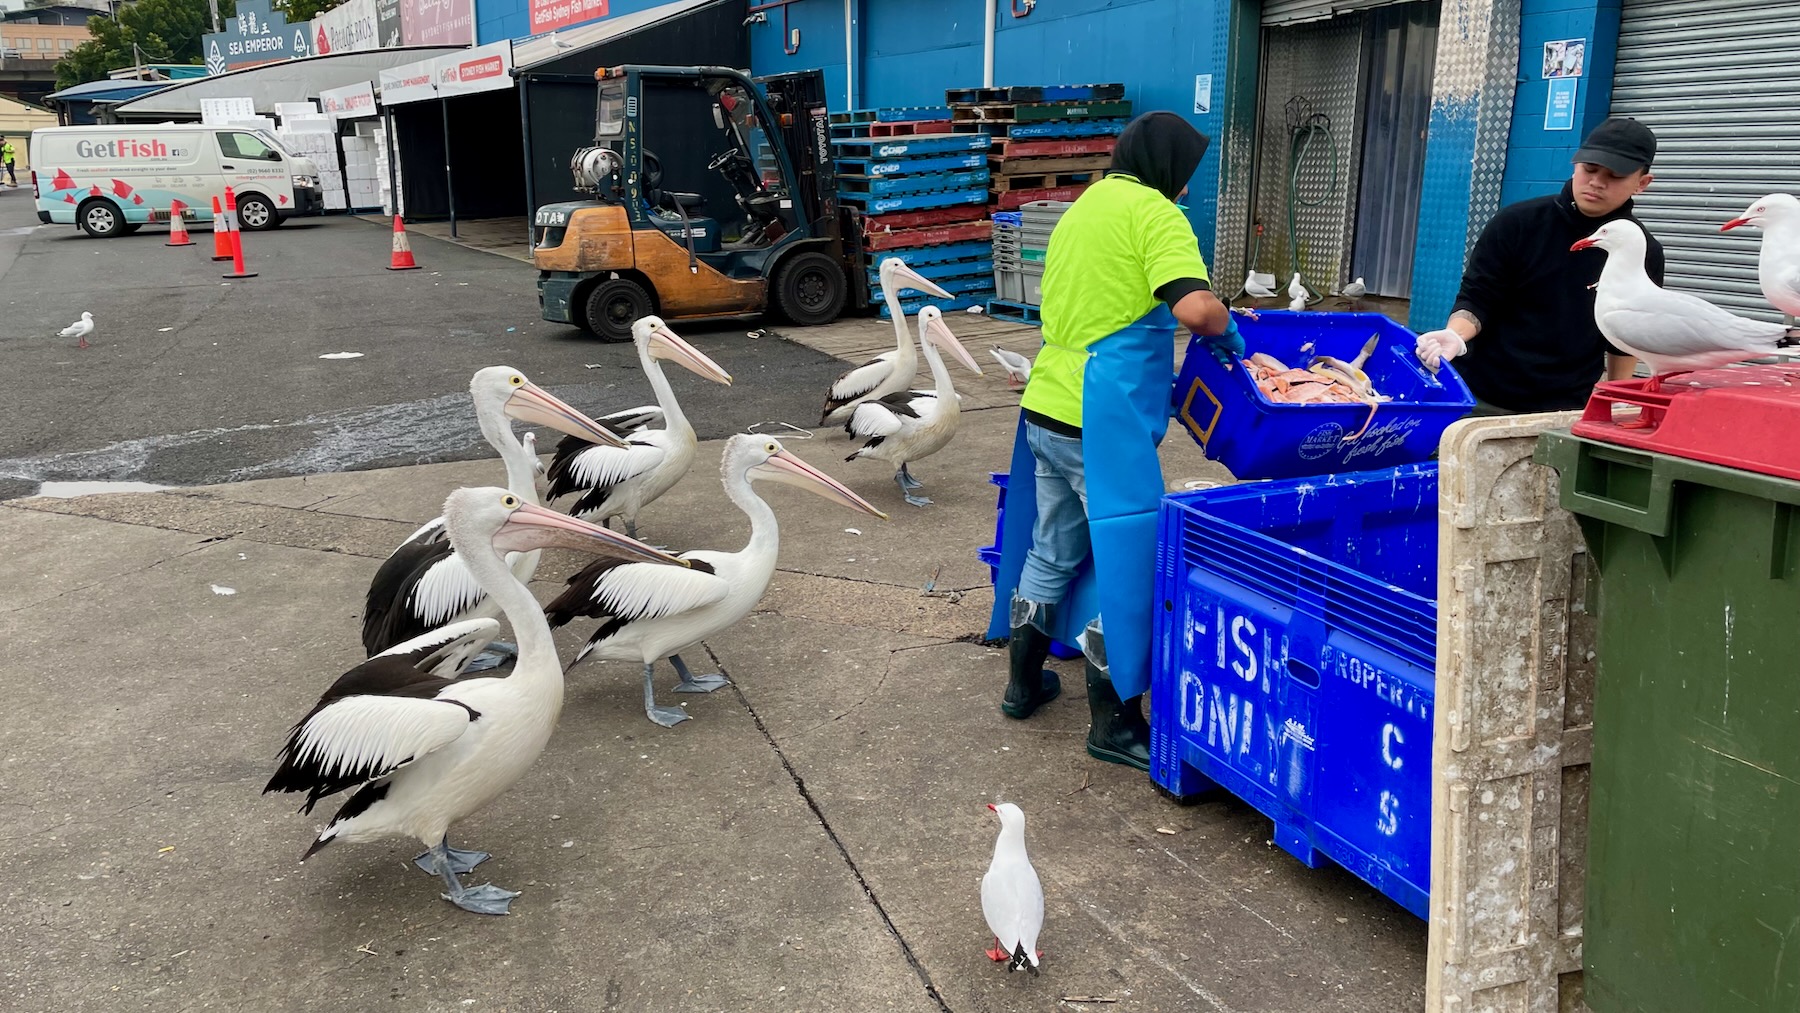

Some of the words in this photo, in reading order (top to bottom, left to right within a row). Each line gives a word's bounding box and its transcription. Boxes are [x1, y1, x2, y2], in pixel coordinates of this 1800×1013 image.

[228, 41, 244, 55] SEA
[245, 36, 283, 54] EMPEROR
[76, 138, 167, 158] GetFish
[815, 119, 828, 164] TOYOTA
[681, 228, 706, 239] 25
[1305, 435, 1340, 444] MARKET
[1184, 592, 1289, 705] FISH
